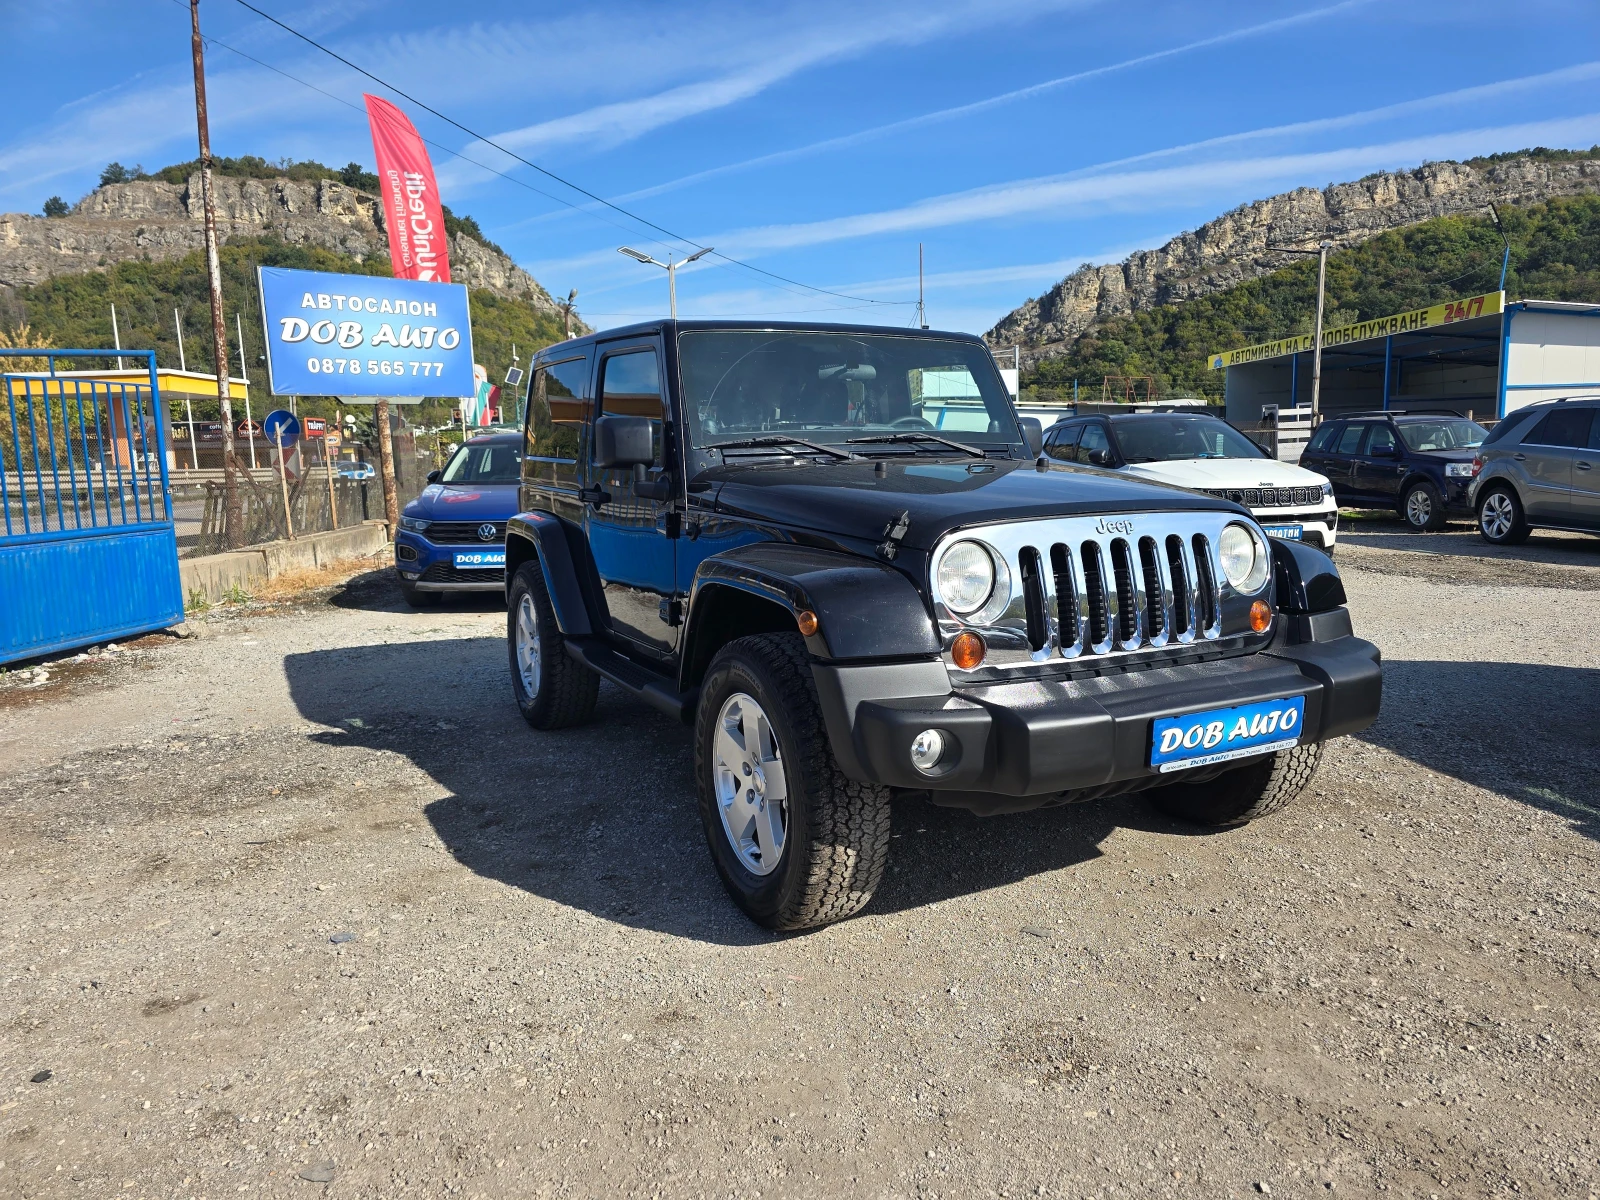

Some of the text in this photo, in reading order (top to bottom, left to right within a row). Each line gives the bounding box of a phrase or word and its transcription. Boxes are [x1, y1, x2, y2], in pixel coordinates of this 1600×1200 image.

[301, 292, 437, 317] АВТОСАЛОН
[1444, 296, 1485, 324] 24/7
[280, 317, 460, 350] DOB AUTO
[1229, 345, 1283, 365] АВТОМИВКА
[1286, 339, 1299, 354] НА
[307, 357, 444, 377] 0878 565 777
[1095, 518, 1134, 535] Jeep
[456, 554, 506, 564] DOB AUT
[1160, 707, 1298, 753] DOB AUTO
[1189, 758, 1208, 766] DOB
